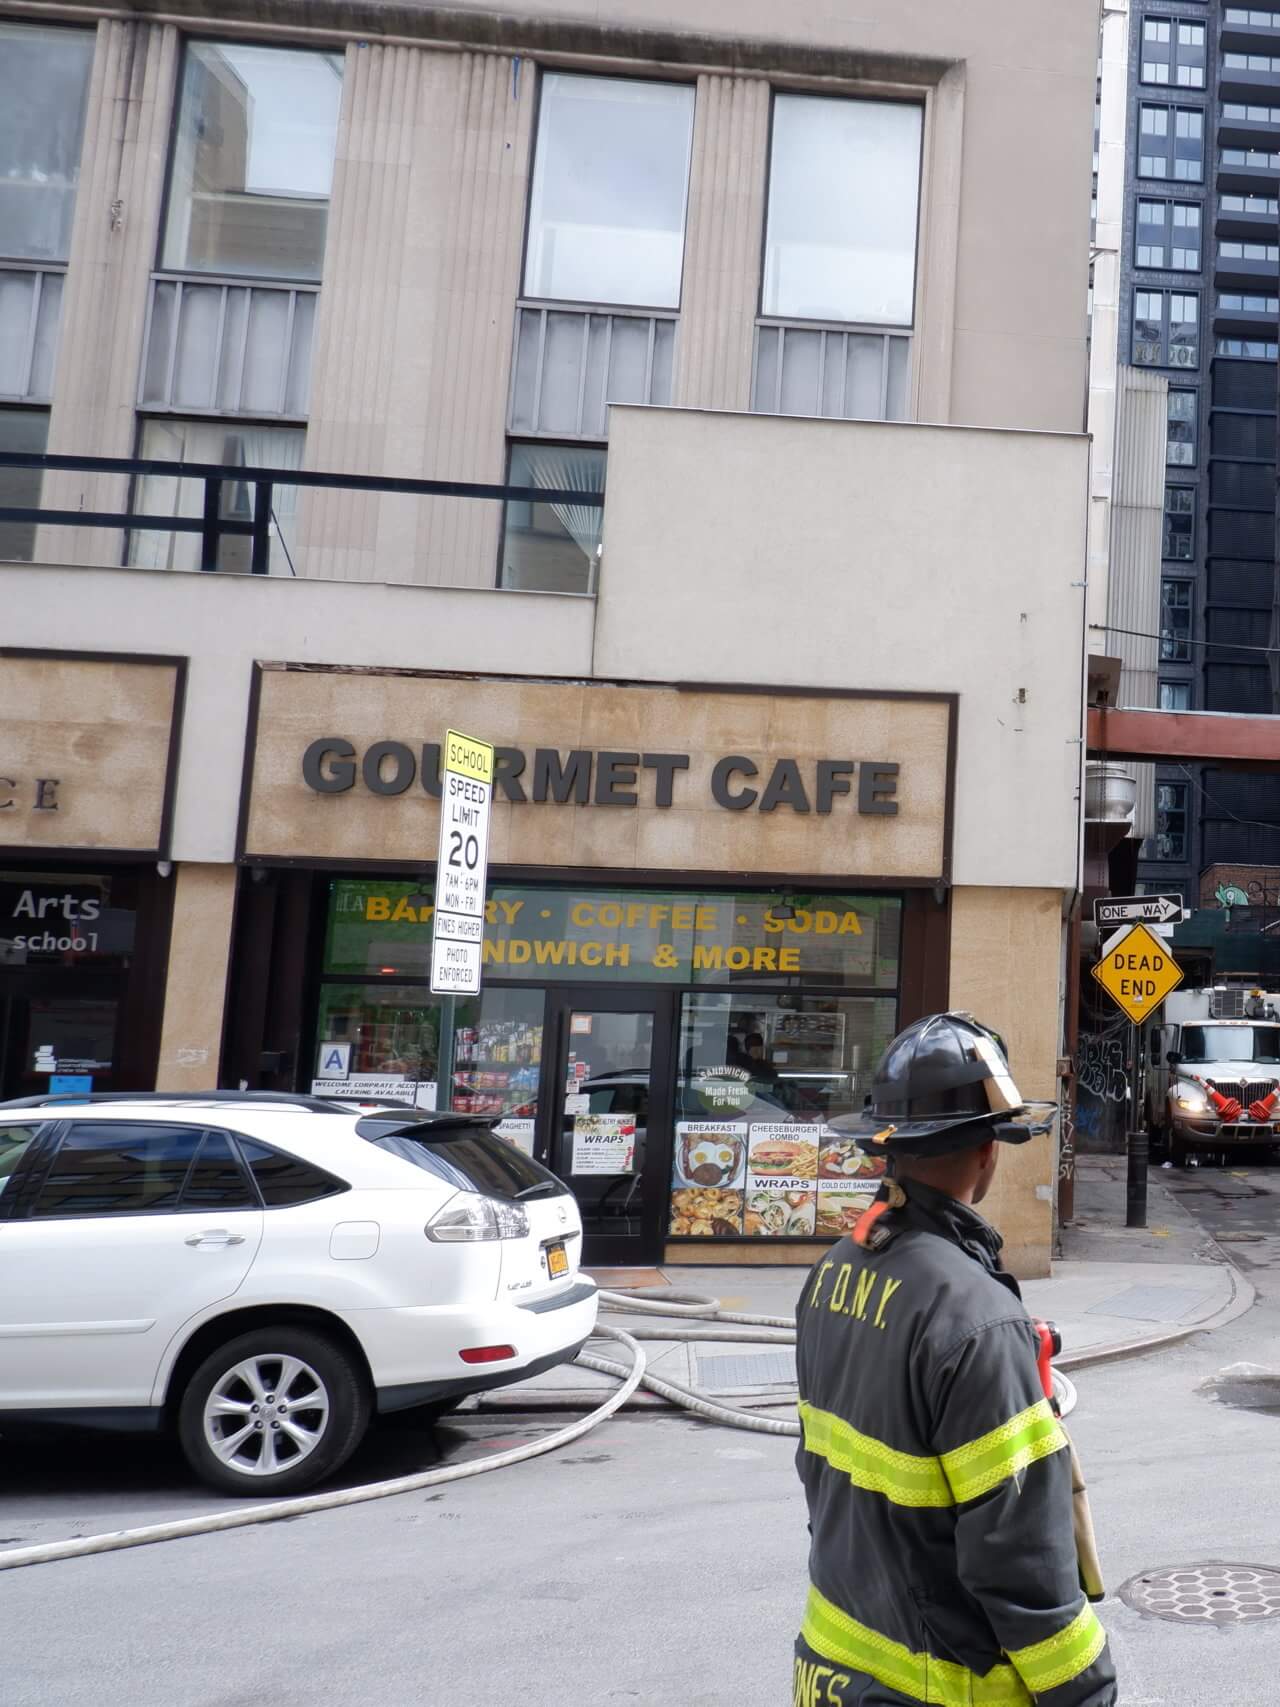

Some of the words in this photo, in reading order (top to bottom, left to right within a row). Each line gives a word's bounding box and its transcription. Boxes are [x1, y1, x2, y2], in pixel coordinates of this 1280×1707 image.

[451, 744, 488, 773] SCHOOL
[450, 778, 486, 804] SPEED
[711, 755, 900, 815] CAFE
[452, 804, 480, 827] LIMIT
[449, 830, 478, 870] 20
[445, 873, 459, 888] 7AM
[465, 877, 479, 892] 6PM
[12, 890, 100, 920] Arts
[445, 894, 459, 908] MON
[465, 896, 477, 912] FRI
[1102, 906, 1128, 919] ONE
[1143, 904, 1169, 916] WAY
[438, 918, 455, 933] FINES
[458, 921, 480, 937] HIGHER
[570, 902, 719, 931] COFFEE
[763, 910, 863, 935] SODA
[13, 931, 98, 952] school
[447, 947, 468, 963] PHOTO
[484, 939, 630, 967] NDWICH
[653, 943, 679, 969] &
[693, 945, 801, 972] MORE
[1114, 954, 1163, 971] DEAD
[439, 966, 473, 983] ENFORCED
[1121, 979, 1156, 996] END
[325, 1049, 343, 1069] A
[705, 1086, 726, 1096] Made
[712, 1097, 725, 1106] For
[727, 1096, 740, 1106] You
[687, 1124, 737, 1132] BREAKFAST
[752, 1125, 818, 1133] CHEESEBURGER
[769, 1133, 800, 1141] COMBO
[584, 1135, 624, 1143] WRAPS
[755, 1180, 809, 1189] WRAPS
[810, 1262, 902, 1329] F.D.N.Y.
